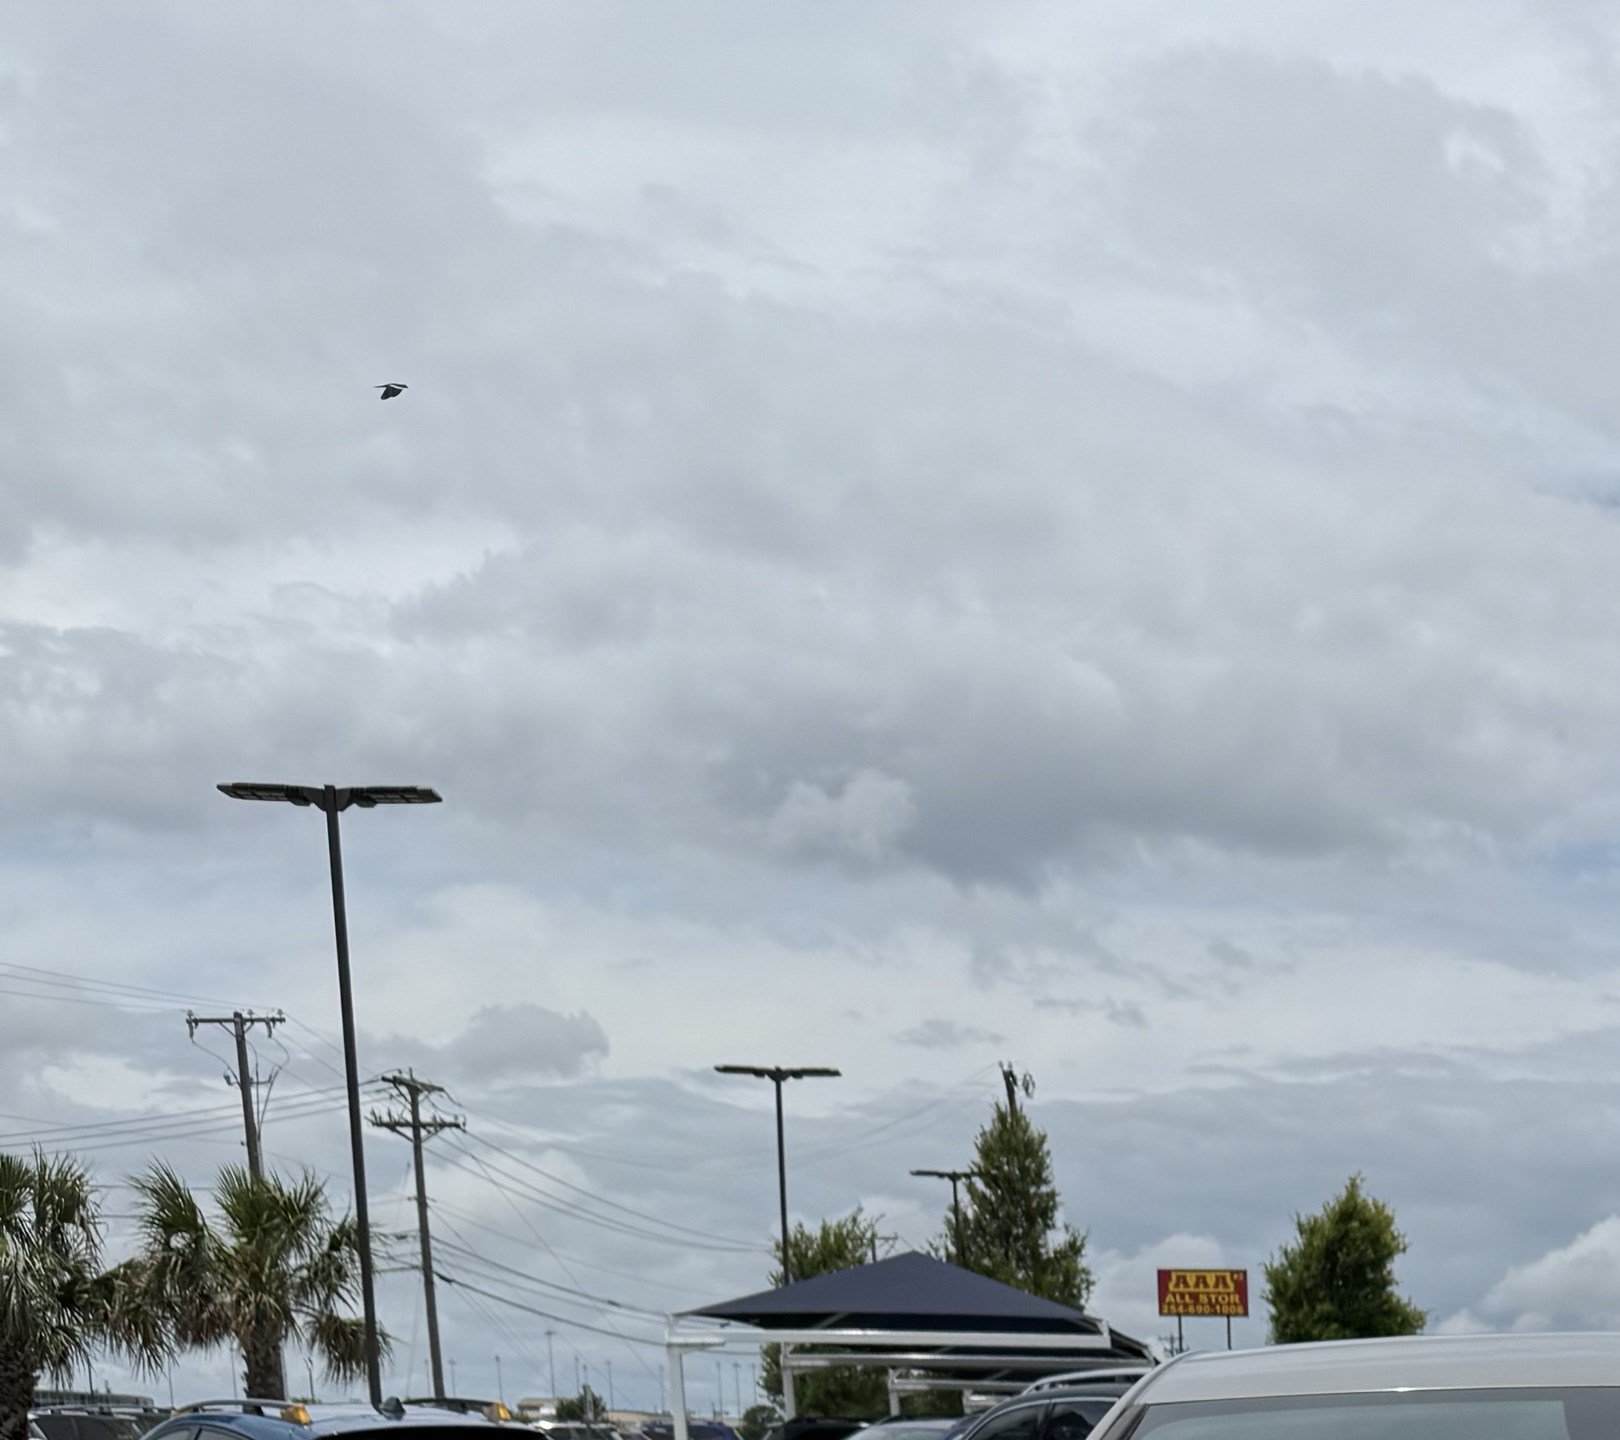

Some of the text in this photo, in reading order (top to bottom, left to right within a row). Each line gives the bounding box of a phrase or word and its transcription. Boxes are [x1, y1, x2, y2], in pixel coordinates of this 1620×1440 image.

[1171, 1273, 1233, 1290] AAA
[1165, 1293, 1240, 1305] ALL STOR
